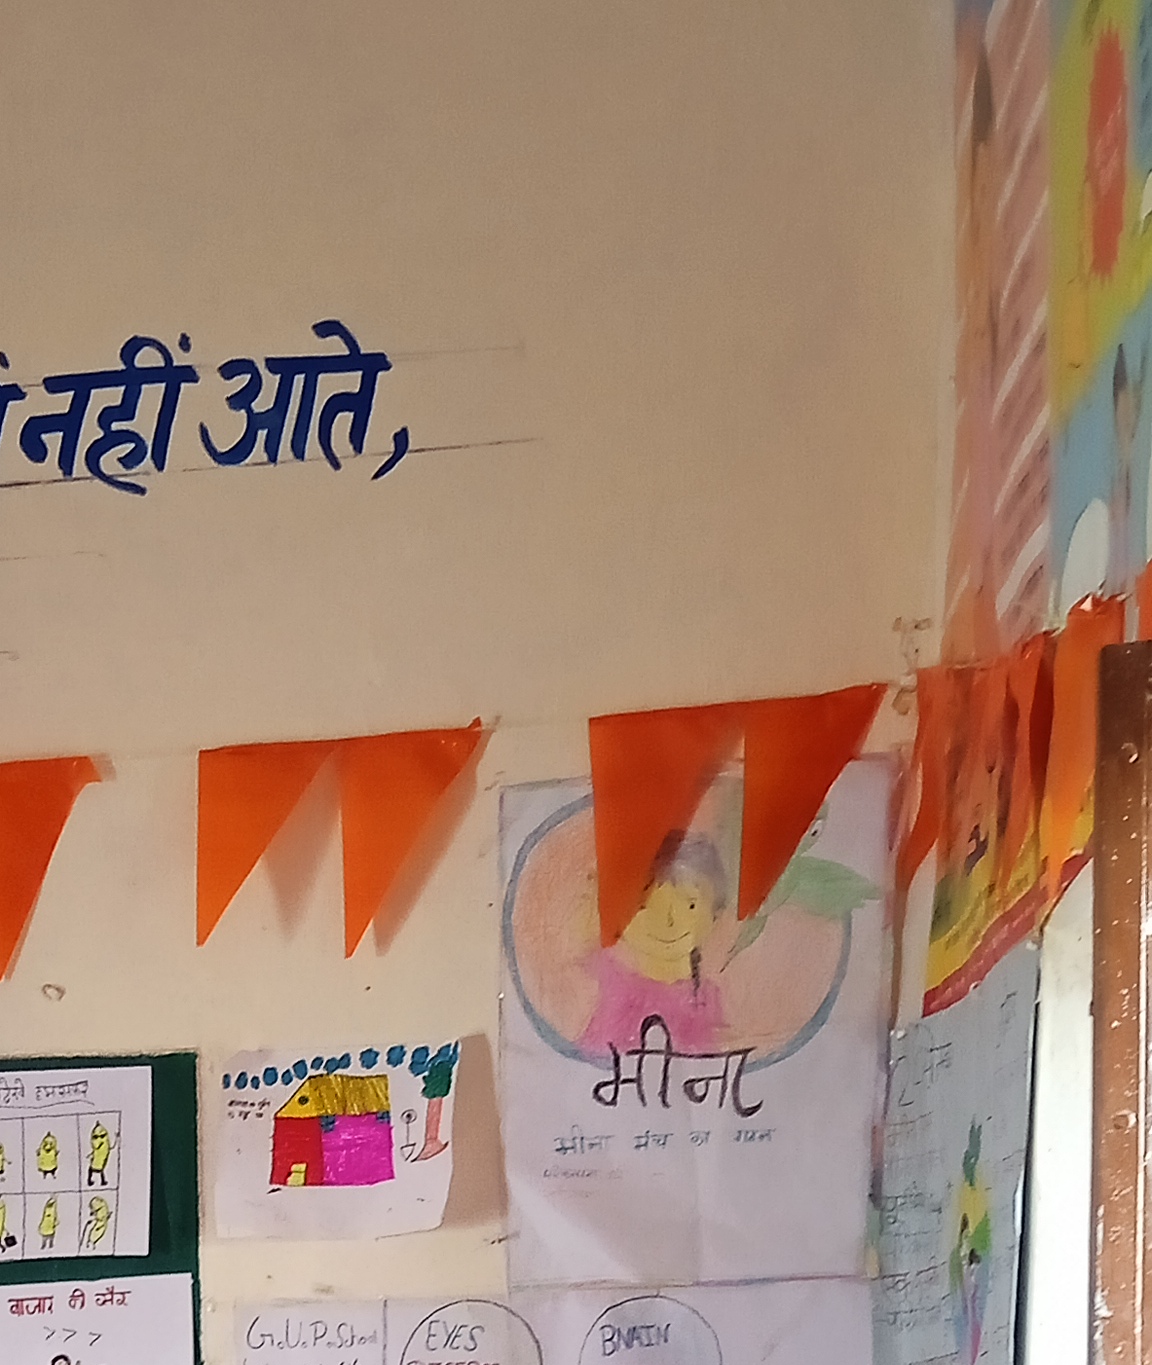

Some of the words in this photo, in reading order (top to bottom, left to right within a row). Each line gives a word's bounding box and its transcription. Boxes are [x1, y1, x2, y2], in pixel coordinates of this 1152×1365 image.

[20, 333, 199, 495] नहीं
[199, 320, 410, 481] आते,
[591, 1014, 762, 1118] मीना
[425, 1320, 484, 1351] EYES
